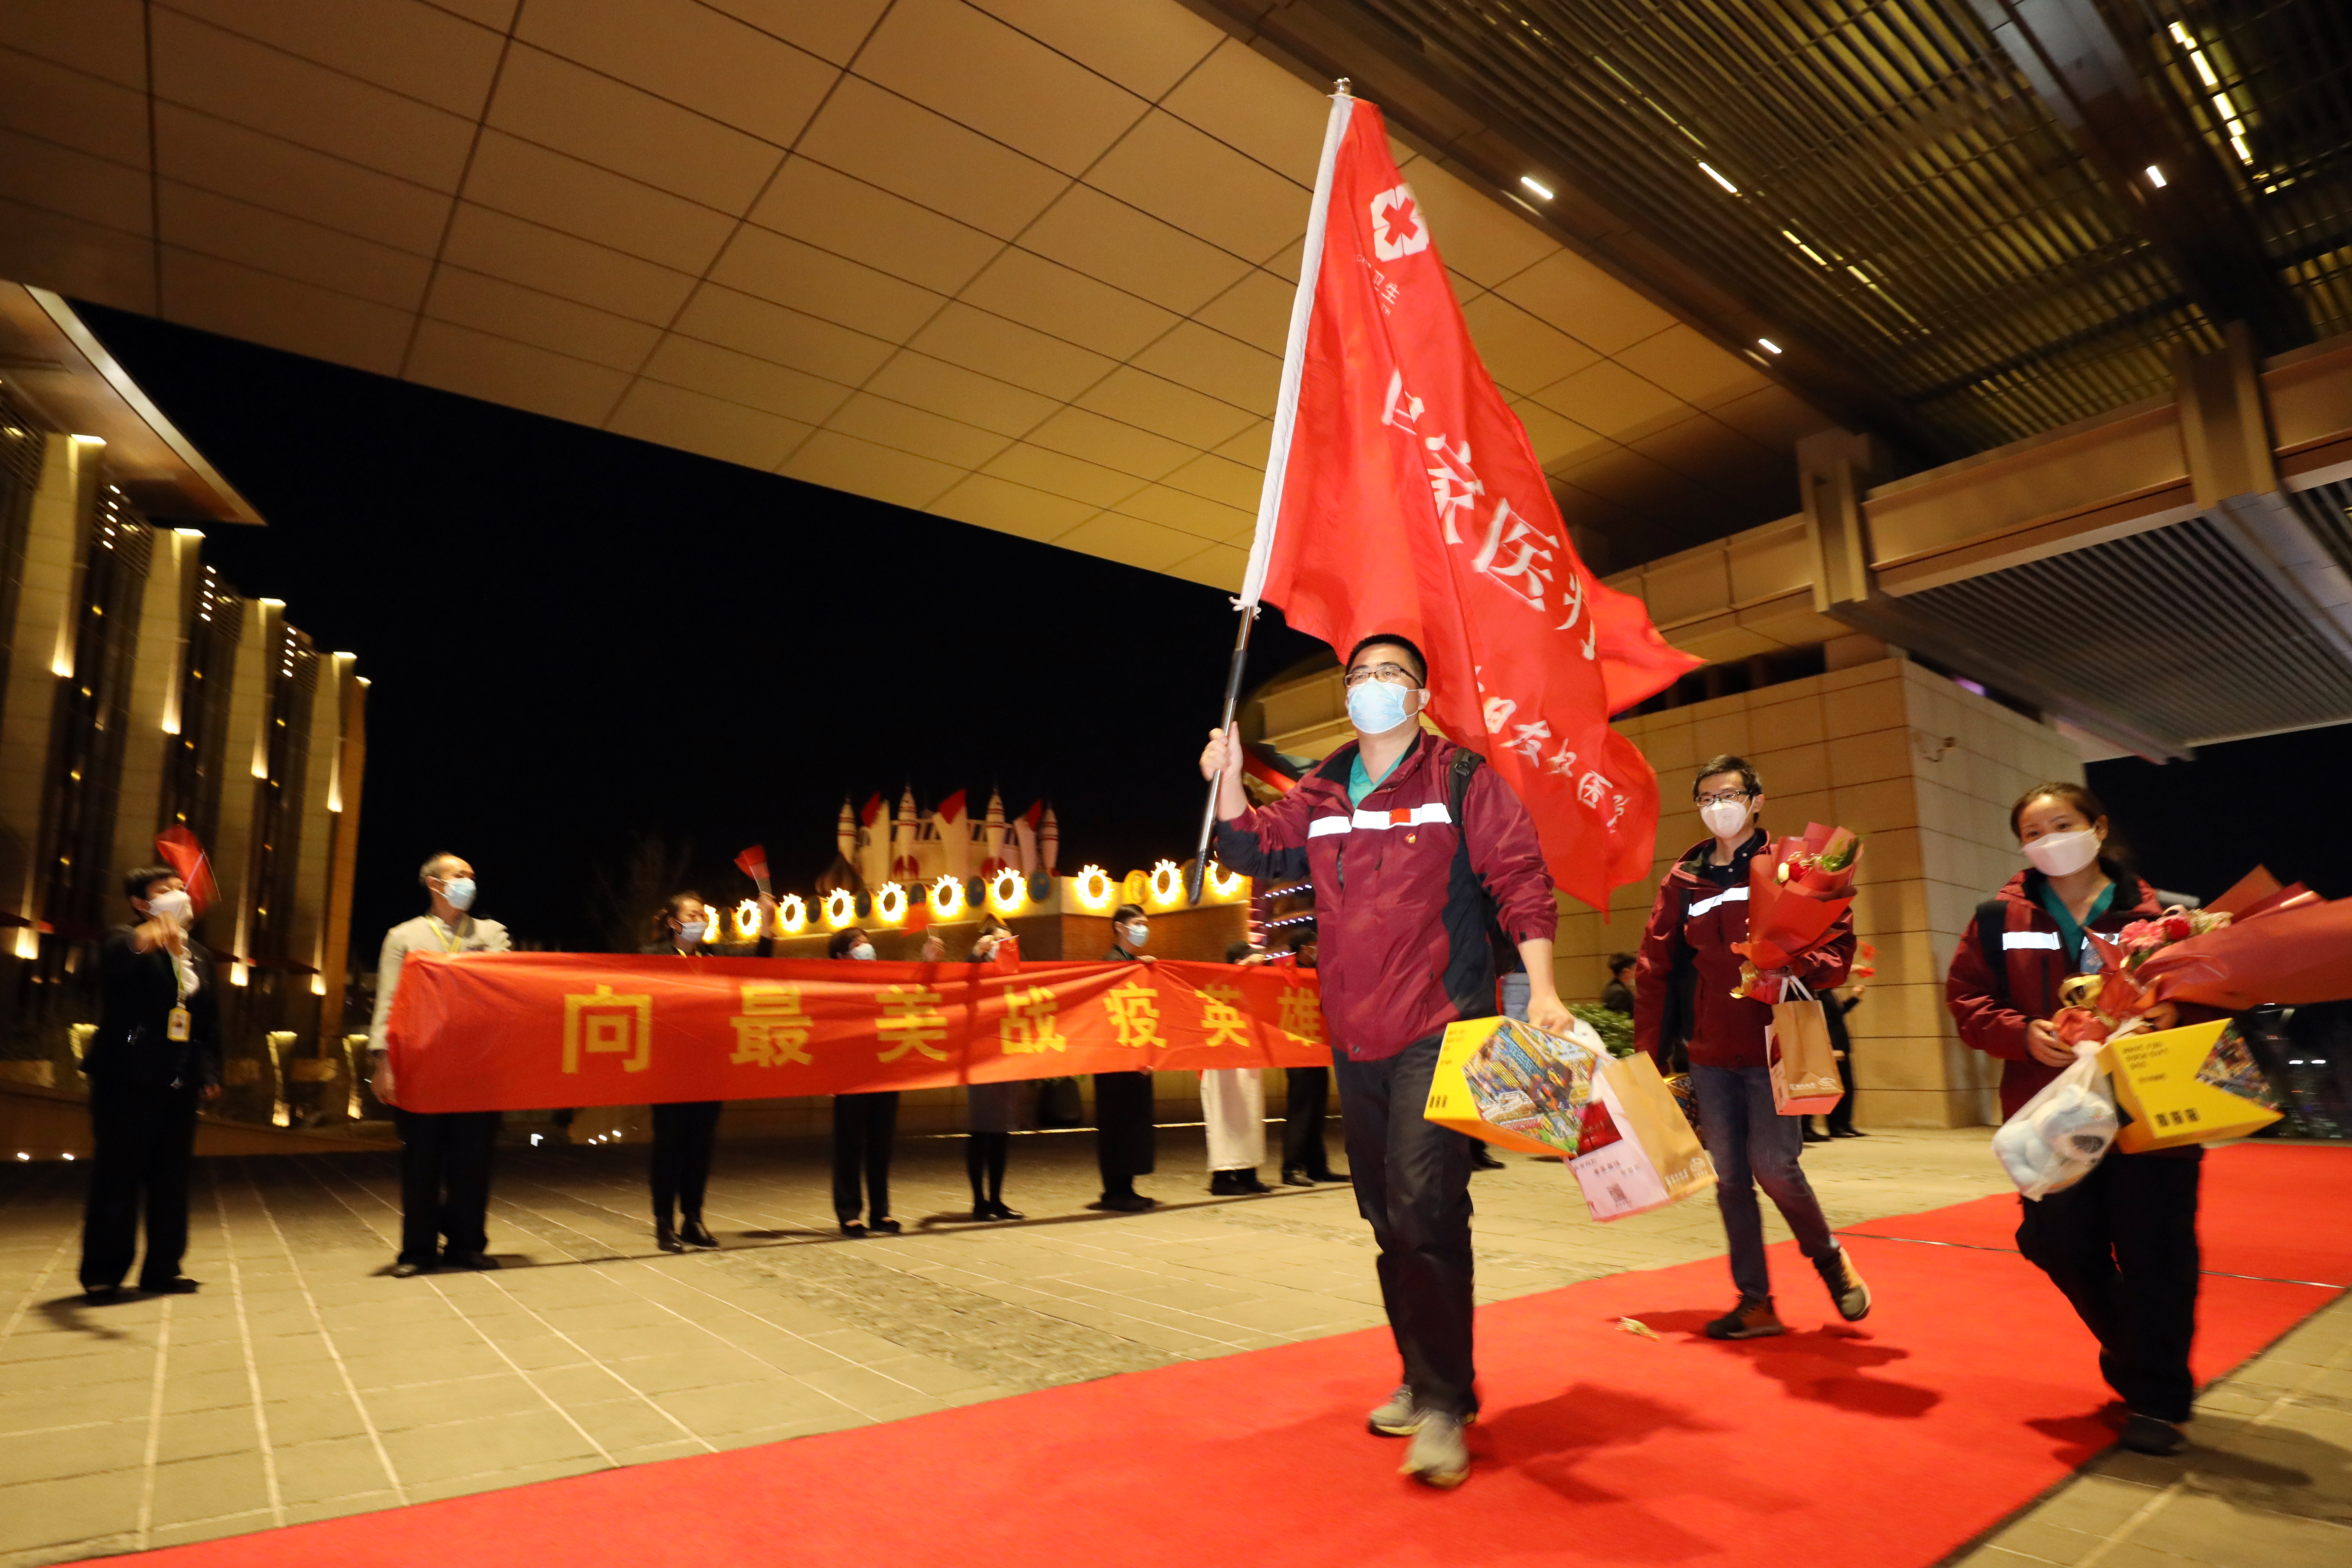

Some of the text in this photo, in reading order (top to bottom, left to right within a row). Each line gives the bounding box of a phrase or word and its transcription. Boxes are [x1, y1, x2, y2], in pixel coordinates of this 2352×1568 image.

[562, 983, 1323, 1074] 向最美战疫英雄
